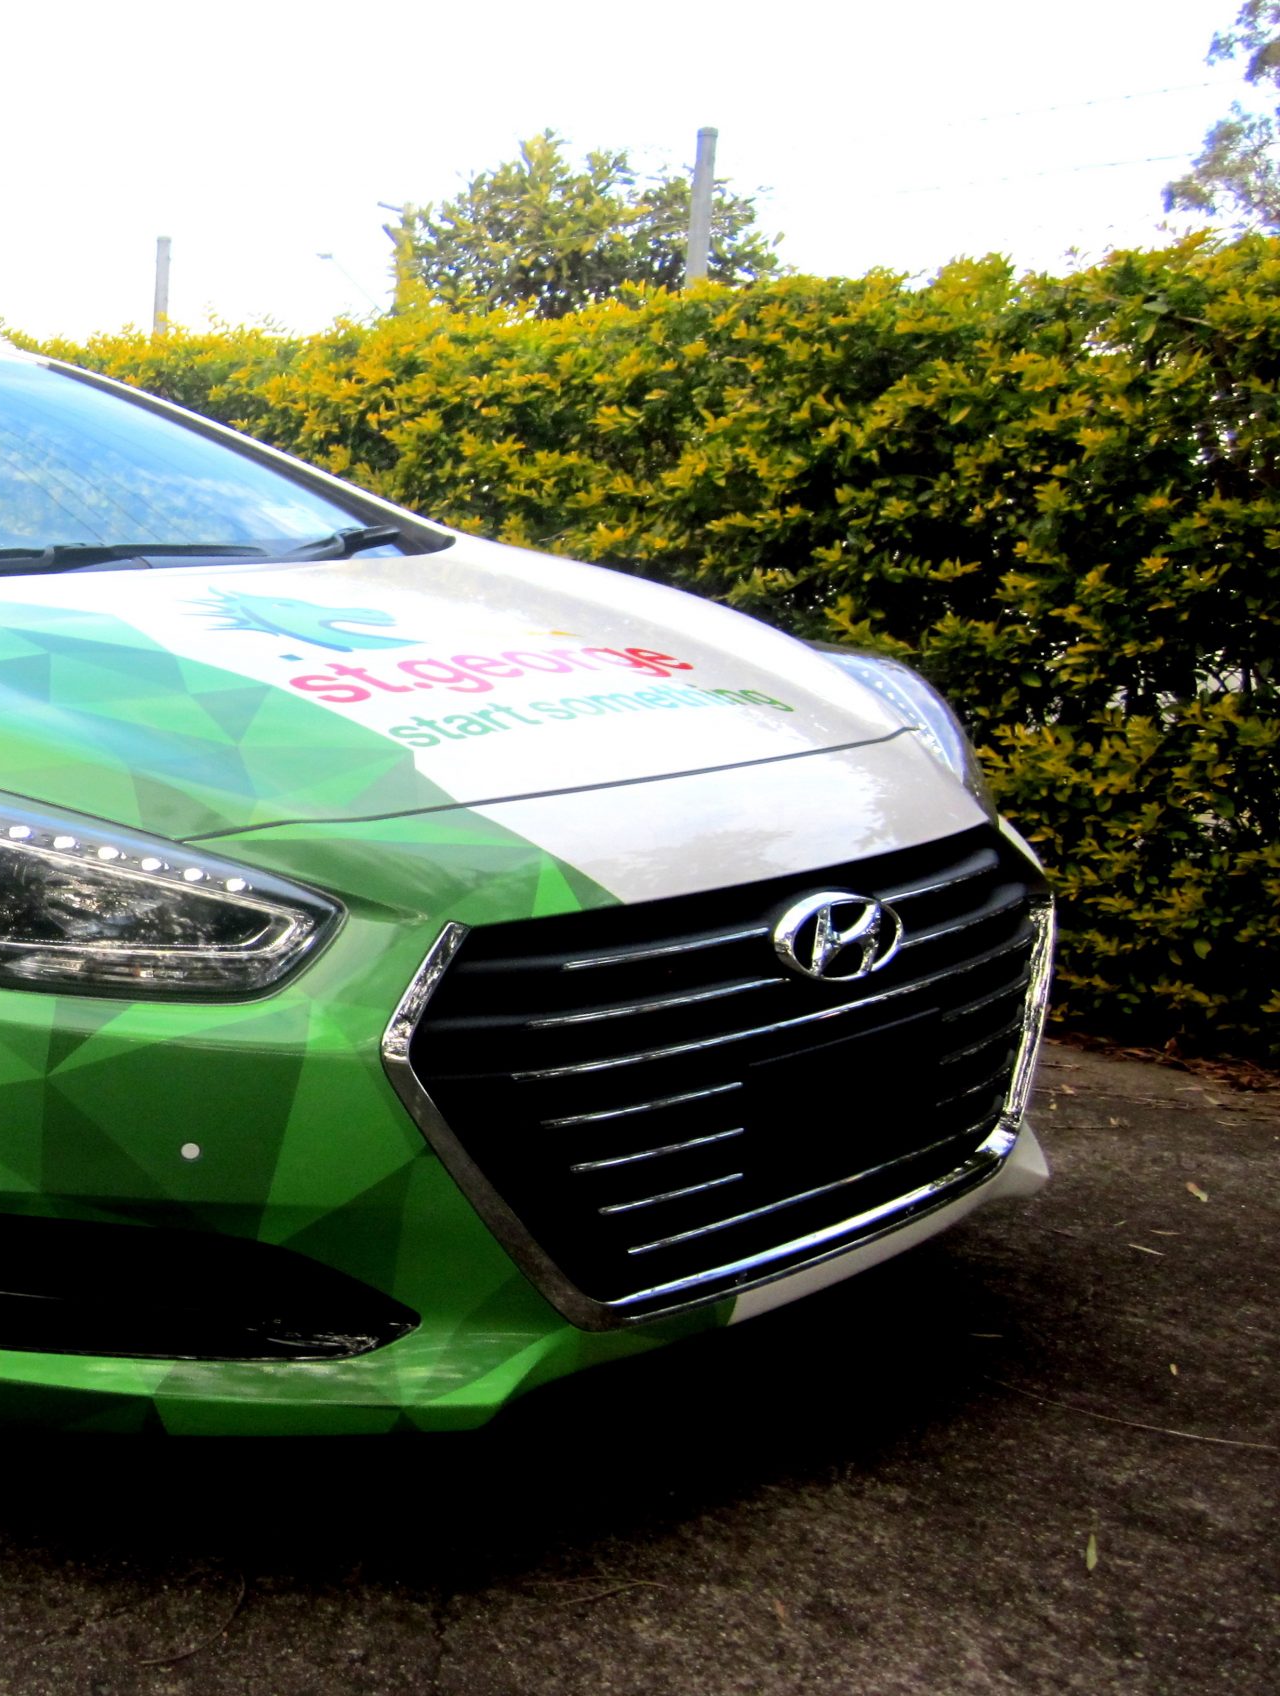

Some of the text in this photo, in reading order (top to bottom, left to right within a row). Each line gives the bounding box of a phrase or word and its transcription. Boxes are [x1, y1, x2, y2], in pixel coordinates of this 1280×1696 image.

[289, 646, 694, 704] st.george
[388, 683, 795, 748] start something
